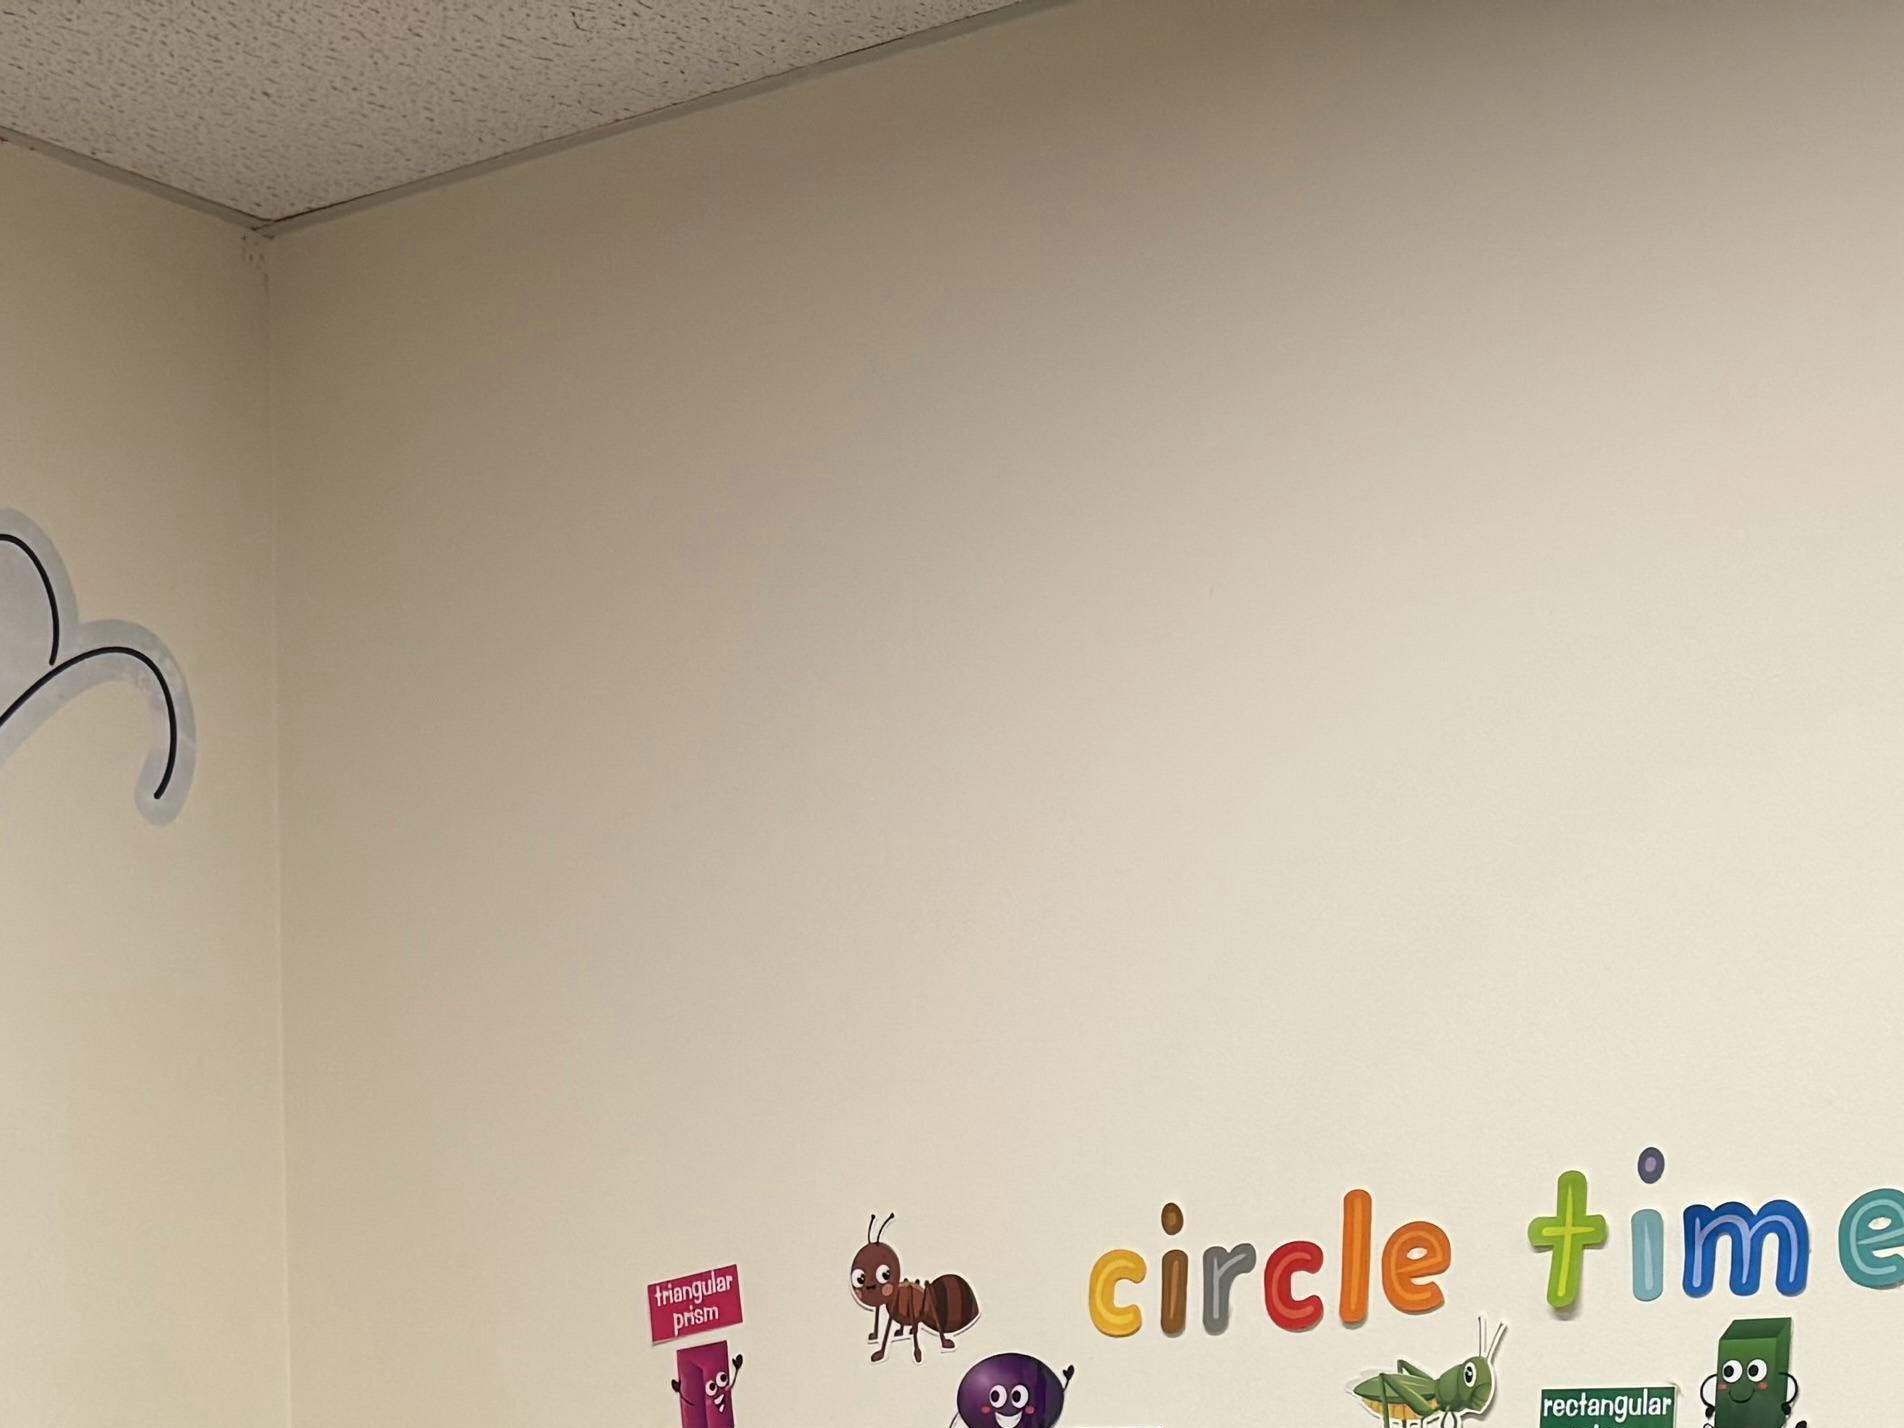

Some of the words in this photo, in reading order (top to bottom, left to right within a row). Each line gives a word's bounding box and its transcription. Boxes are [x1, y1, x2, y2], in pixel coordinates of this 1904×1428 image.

[1089, 1189, 1451, 1336] circle
[654, 1273, 733, 1306] triangular
[672, 1303, 720, 1330] prism
[1543, 1393, 1672, 1422] rectangular
